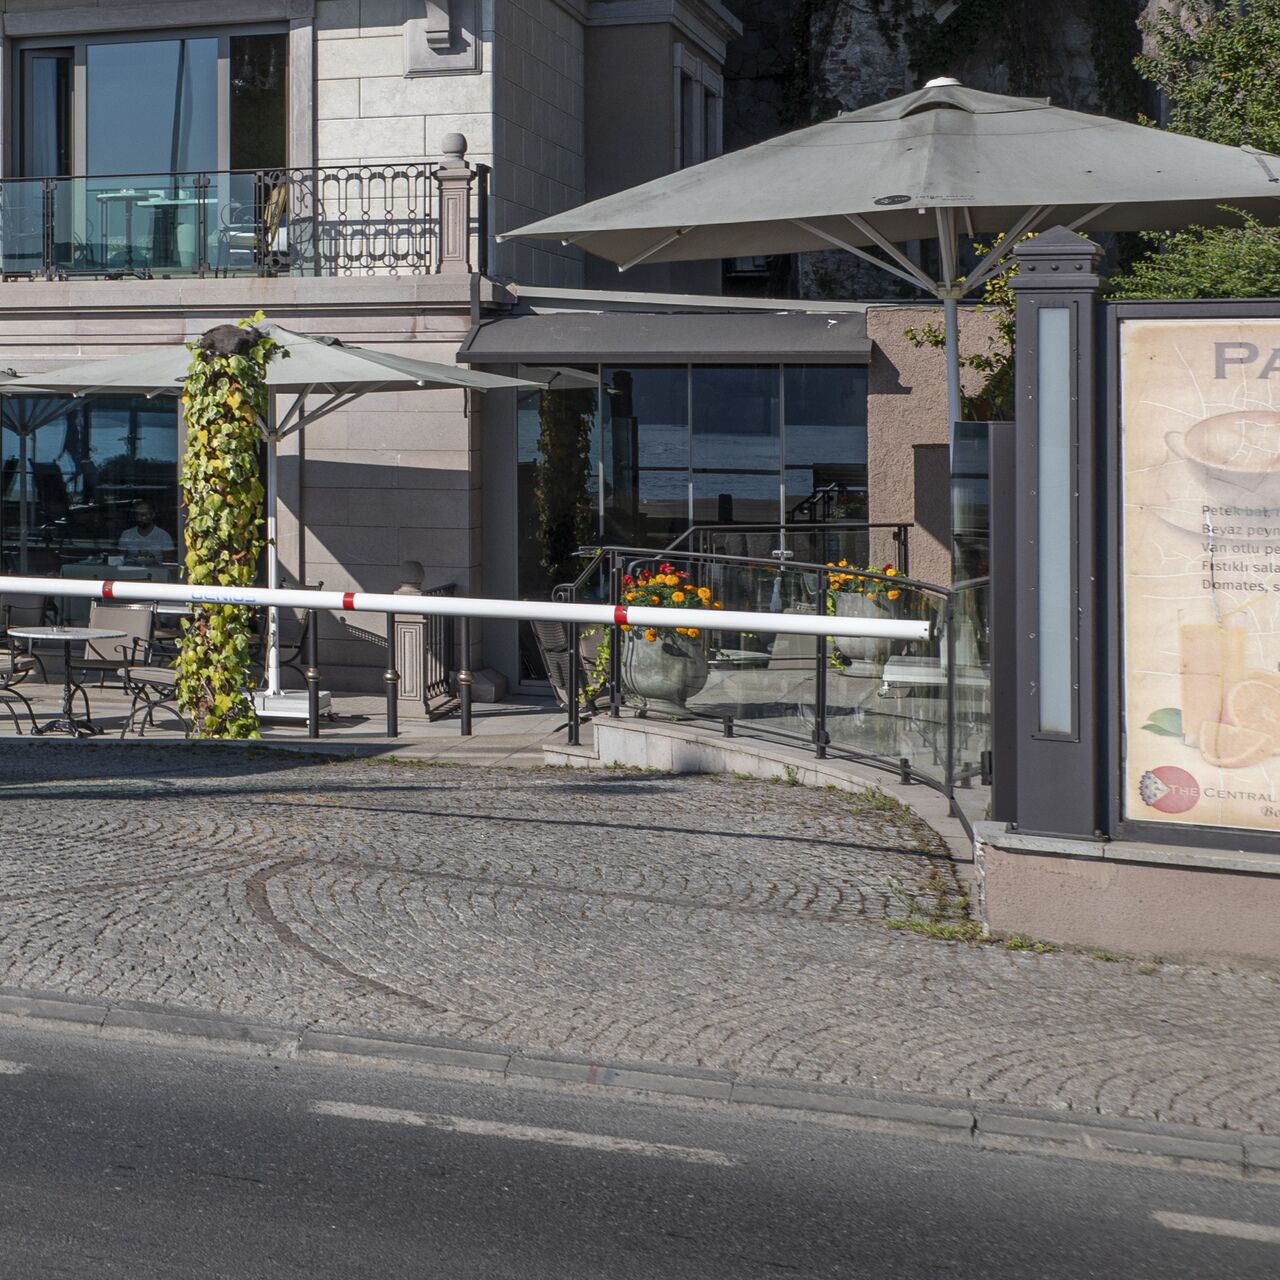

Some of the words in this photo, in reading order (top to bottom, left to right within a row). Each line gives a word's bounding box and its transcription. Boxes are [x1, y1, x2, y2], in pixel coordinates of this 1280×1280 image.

[1202, 505, 1241, 517] Petek
[1202, 523, 1242, 536] Beyaz
[1201, 542, 1227, 553] Van
[1232, 542, 1260, 554] otlu
[1168, 785, 1199, 797] THE
[1203, 787, 1278, 803] CENTRAL
